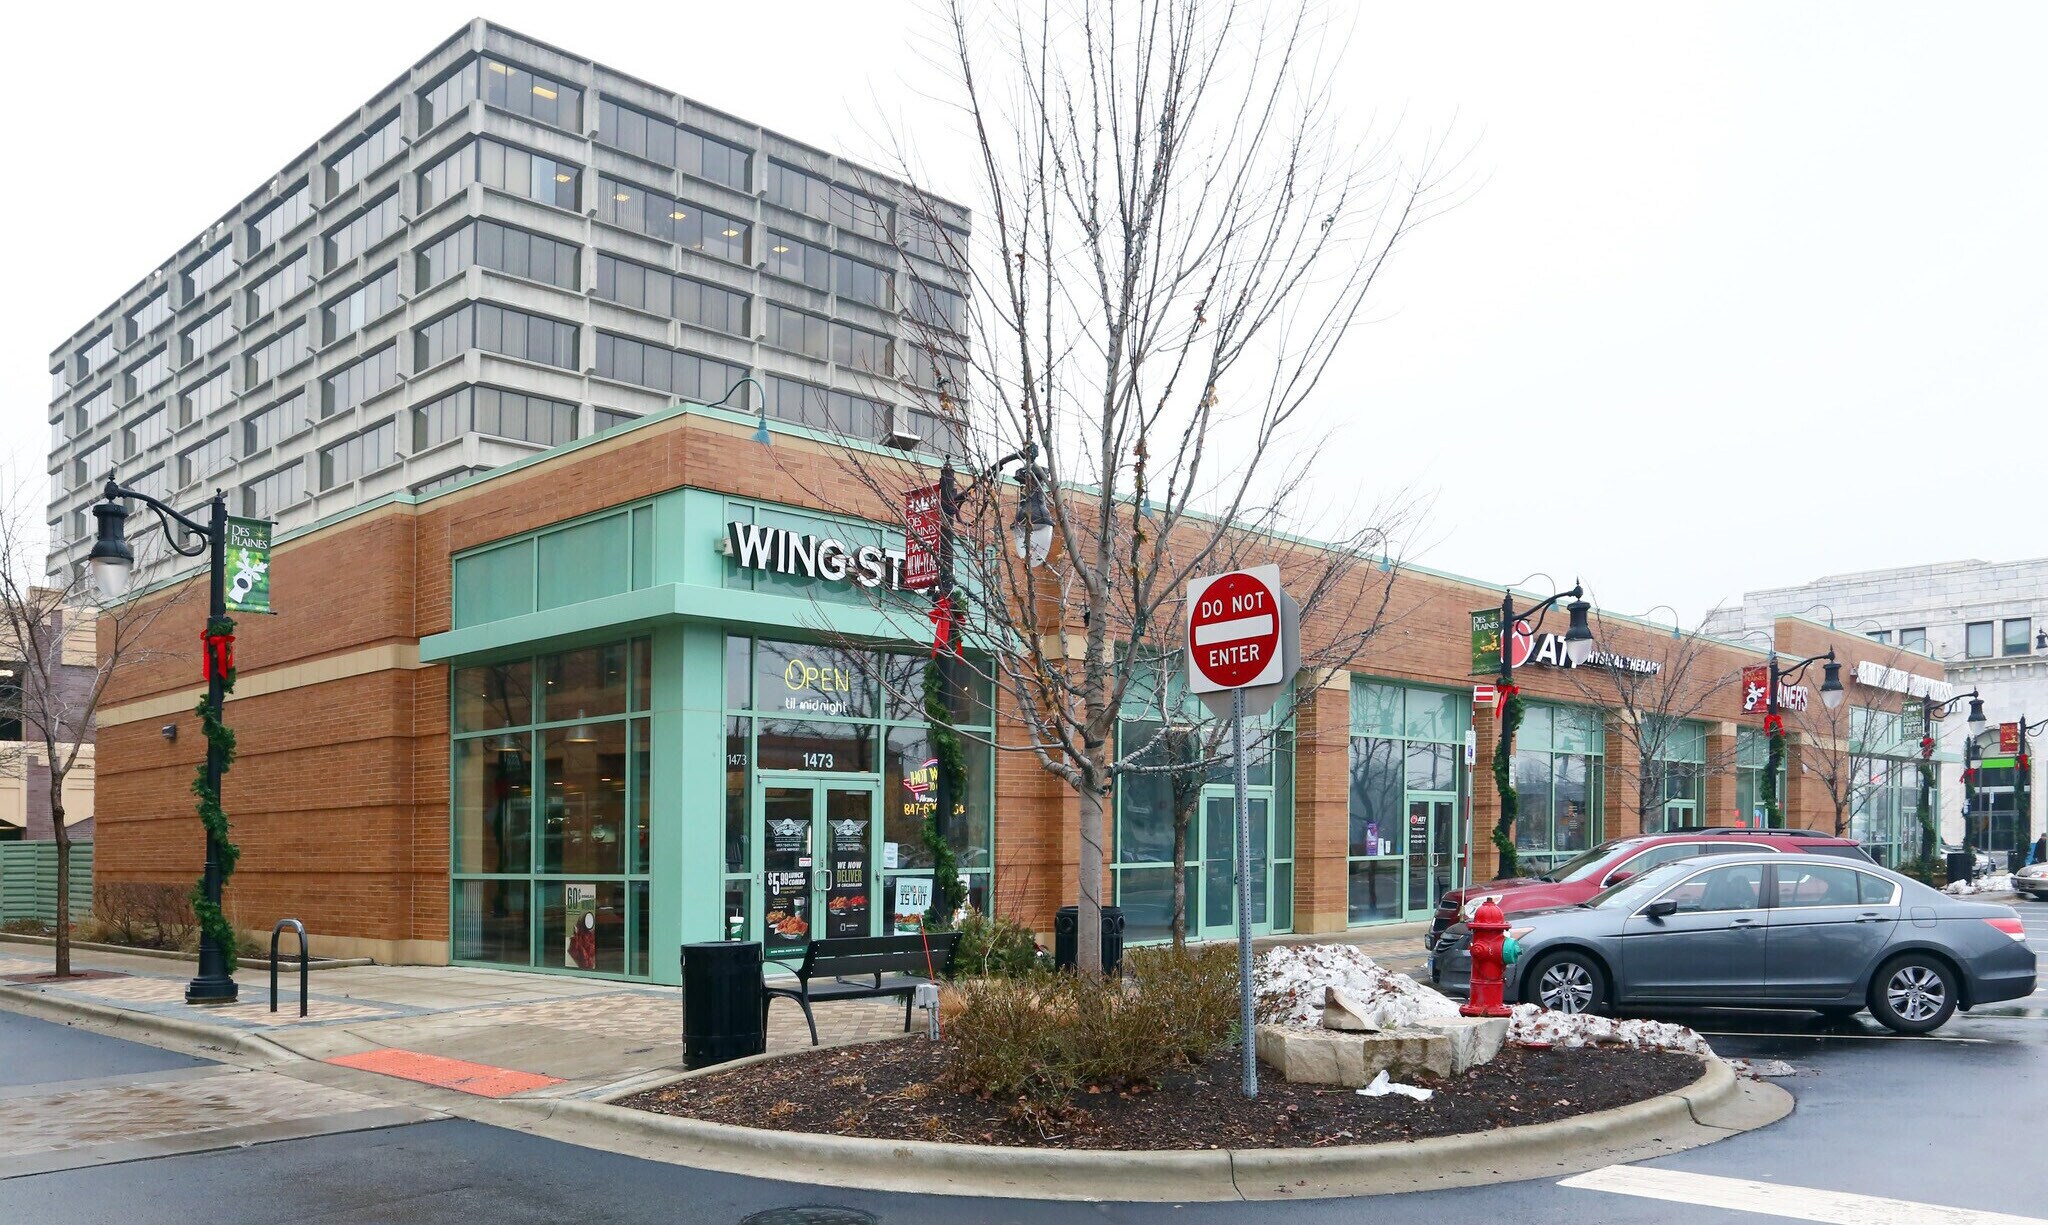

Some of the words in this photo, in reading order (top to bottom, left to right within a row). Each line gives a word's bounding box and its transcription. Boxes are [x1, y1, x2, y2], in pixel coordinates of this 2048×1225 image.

[231, 525, 250, 537] DES
[231, 535, 268, 550] PLAINES
[1202, 599, 1223, 619] DO
[1232, 591, 1264, 613] NOT
[1473, 616, 1486, 624] DES
[1473, 621, 1499, 631] PLAINES
[1209, 643, 1260, 668] ENTER
[785, 659, 849, 692] OPEN
[799, 699, 847, 716] midnight
[727, 754, 747, 766] 1473
[803, 752, 834, 768] 1473
[910, 768, 928, 786] HOT
[837, 870, 863, 883] DELIVER
[900, 893, 910, 906] IS
[912, 893, 927, 906] OUT
